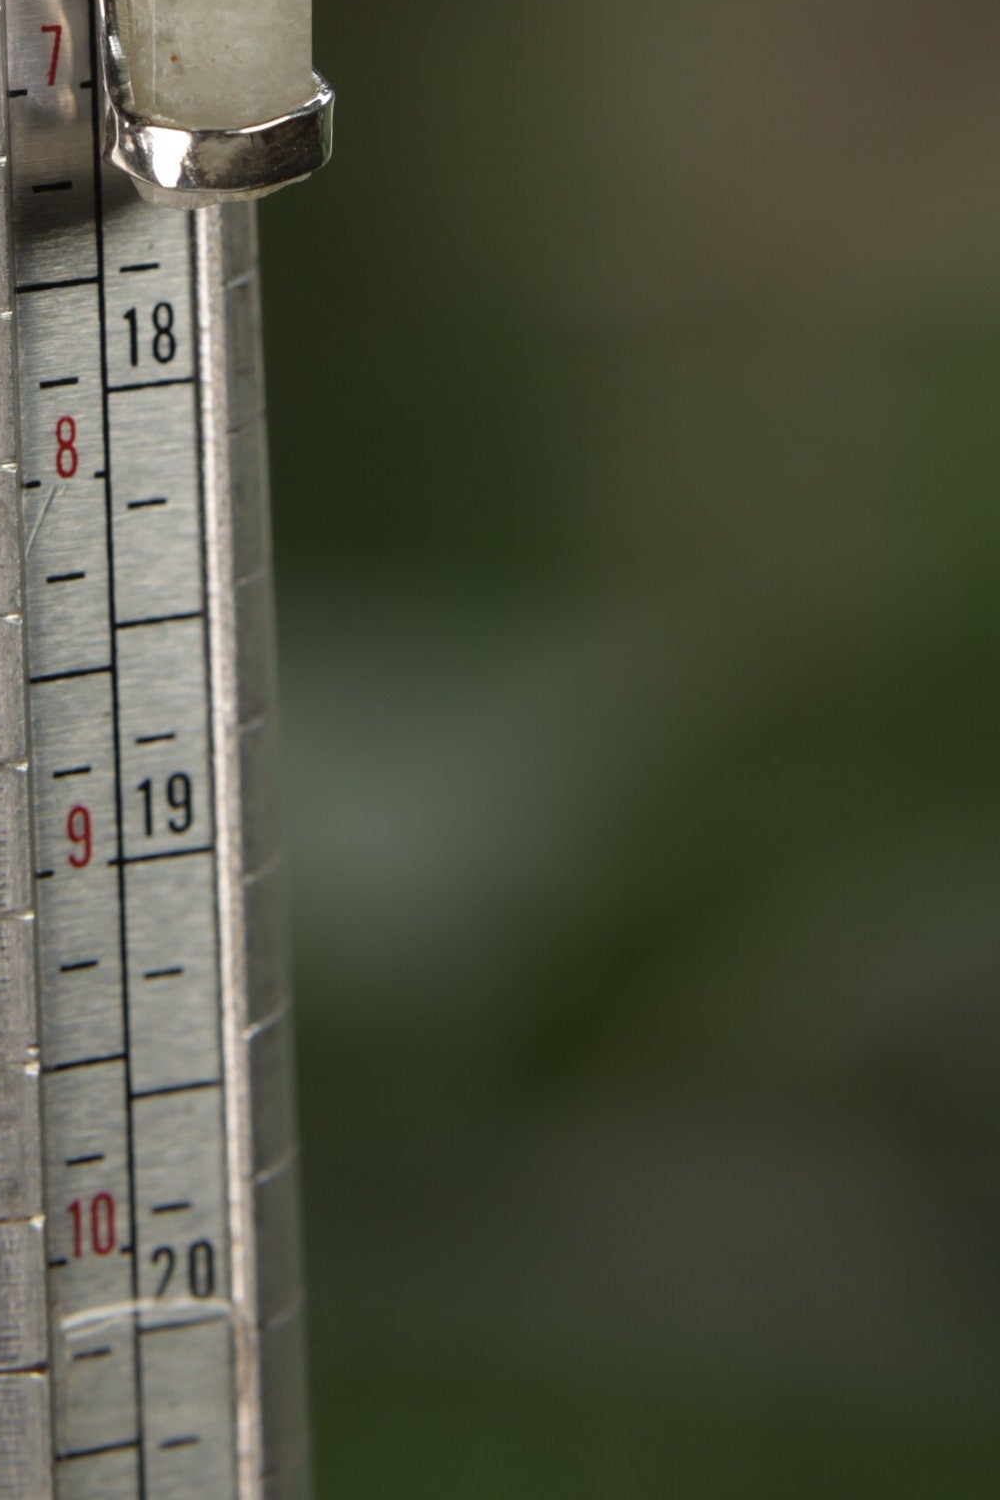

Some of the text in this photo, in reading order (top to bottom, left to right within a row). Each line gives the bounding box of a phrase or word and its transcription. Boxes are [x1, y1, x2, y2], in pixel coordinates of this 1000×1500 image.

[41, 24, 63, 87] 7
[122, 301, 178, 367] 18
[55, 415, 79, 479] 8
[135, 771, 194, 838] 19
[66, 805, 93, 870] 9
[67, 1191, 117, 1259] 10
[150, 1239, 216, 1300] 20
